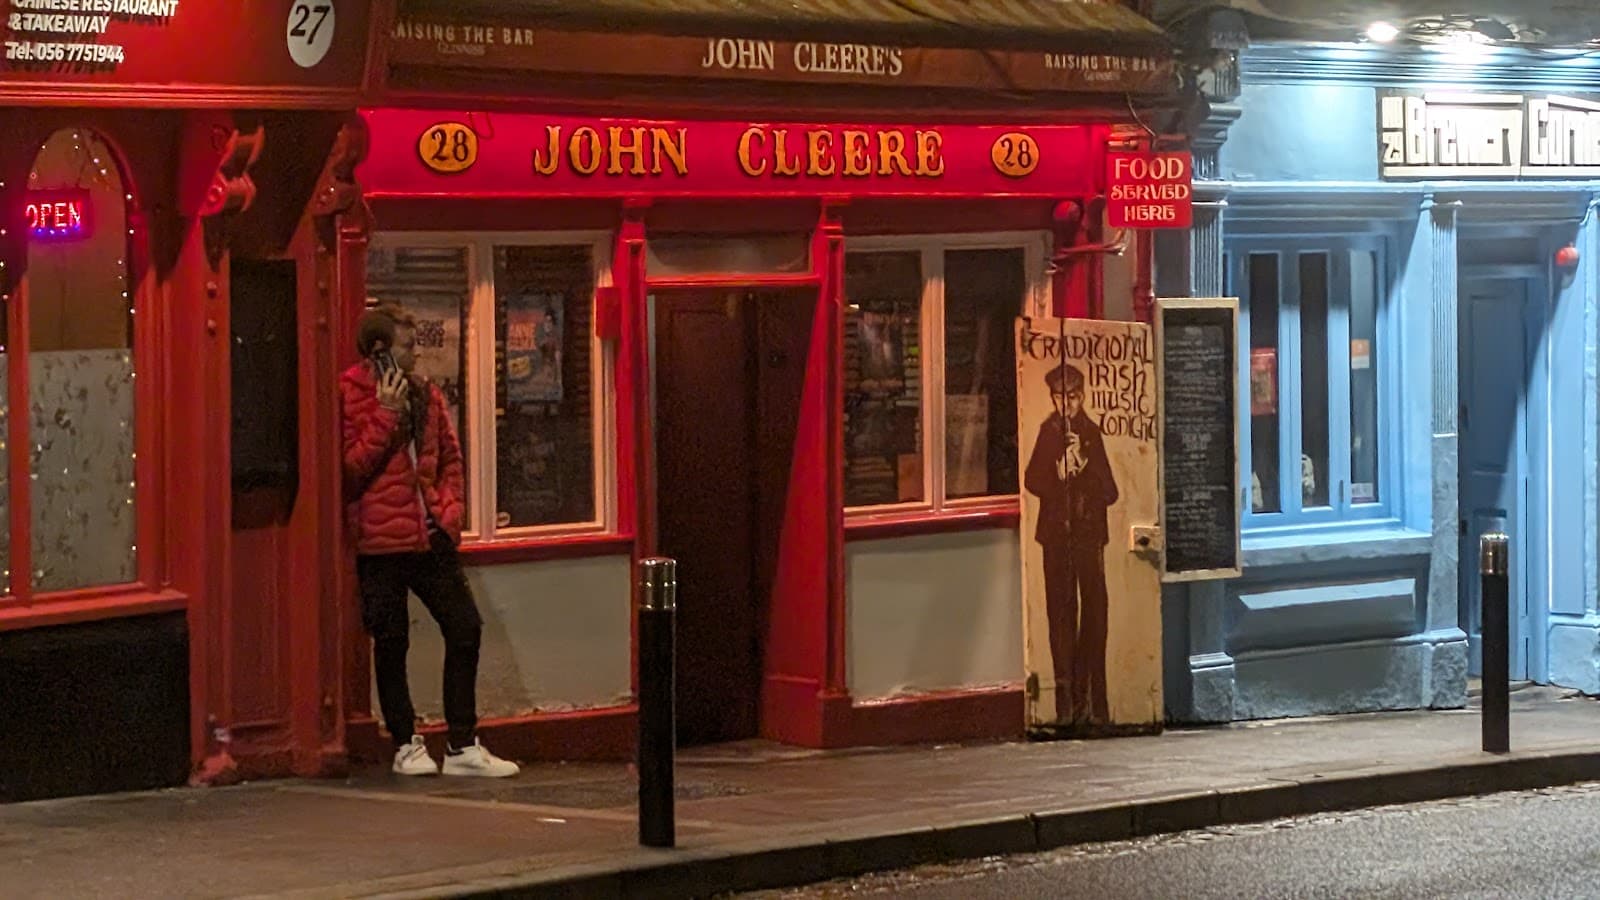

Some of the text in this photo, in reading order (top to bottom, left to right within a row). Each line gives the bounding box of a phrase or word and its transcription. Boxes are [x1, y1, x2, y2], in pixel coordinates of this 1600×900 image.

[82, 0, 179, 17] RESTAURANT
[8, 13, 110, 34] & TAKEAWAY
[289, 5, 331, 46] 27
[463, 26, 494, 44] THE
[503, 28, 534, 45] BAR
[4, 41, 125, 64] Tel: 056 7751944
[702, 38, 903, 77] JOHN CLEERE'S
[1044, 53, 1098, 70] RAISING
[1104, 55, 1128, 71] THE
[431, 128, 469, 162] 28
[533, 125, 945, 178] JOHN CLEERE
[1001, 138, 1031, 168] 28
[1115, 158, 1184, 180] FOOD
[1110, 184, 1189, 201] SERVED
[25, 202, 81, 228] OPEN
[1124, 204, 1176, 222] HERE
